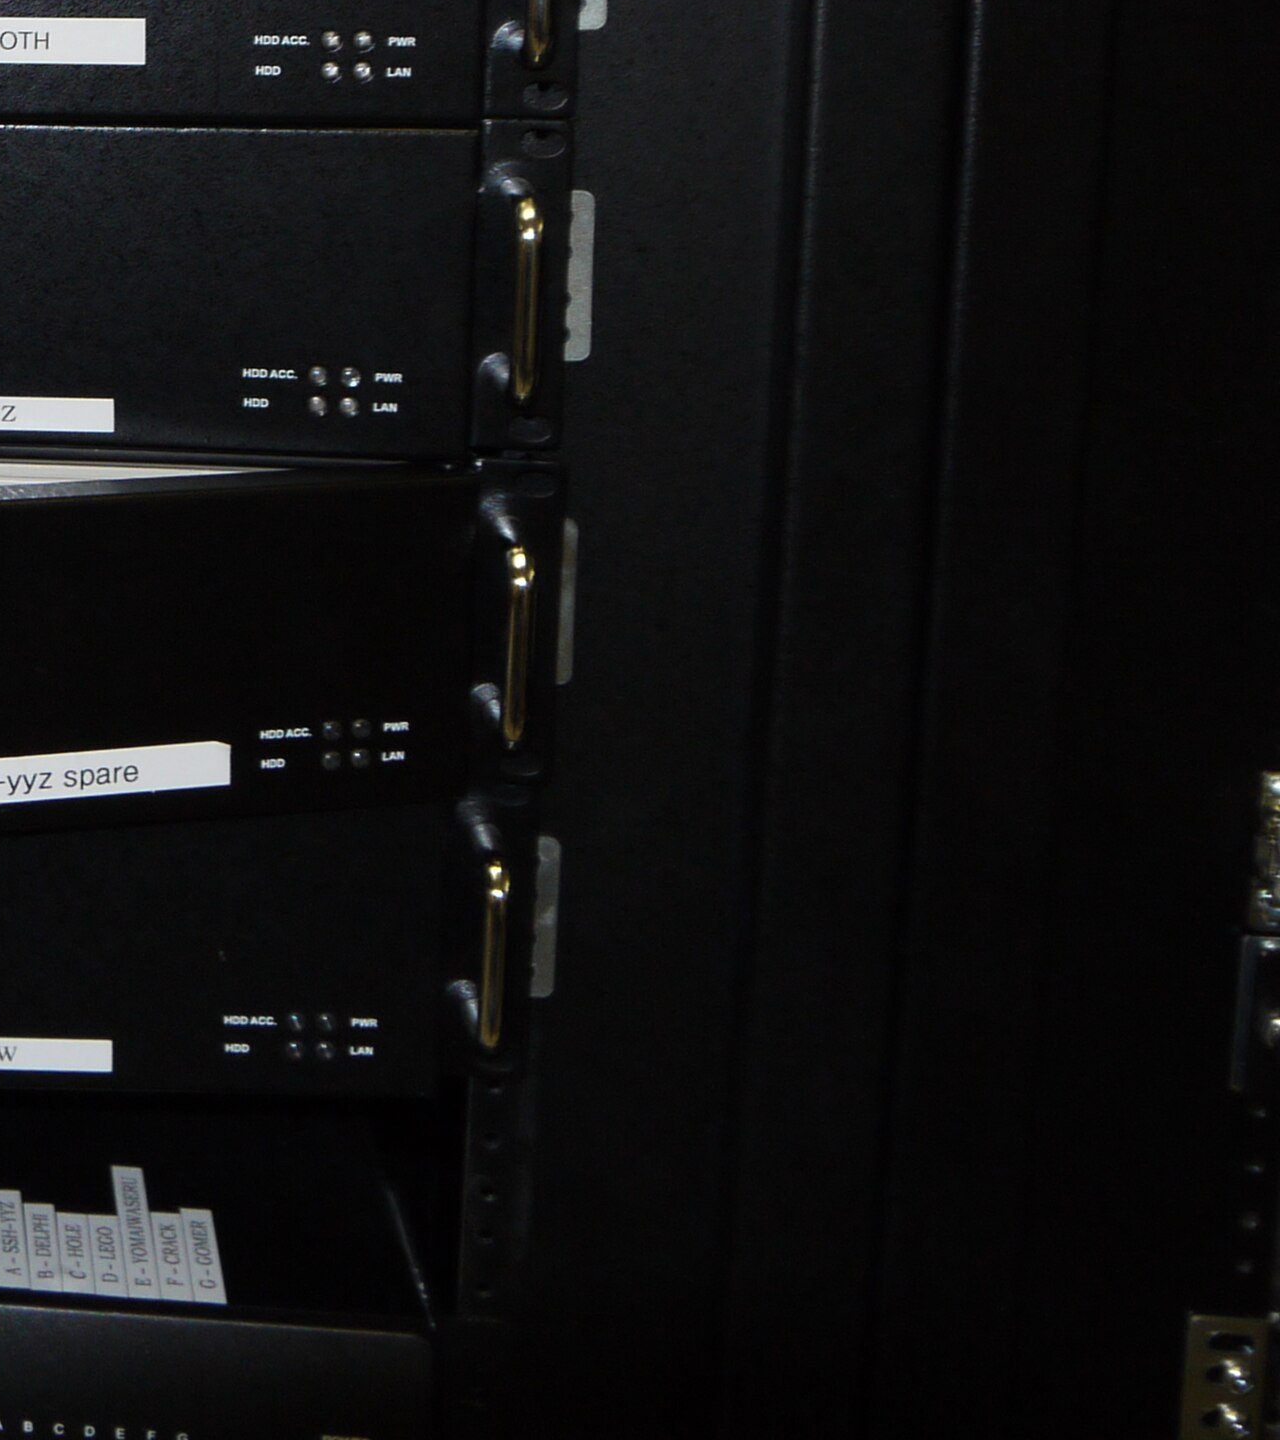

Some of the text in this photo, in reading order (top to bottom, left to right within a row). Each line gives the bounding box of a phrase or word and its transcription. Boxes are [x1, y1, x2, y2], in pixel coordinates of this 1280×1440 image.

[253, 35, 280, 46] HDD
[387, 36, 416, 47] PWR
[255, 65, 282, 76] HDD
[385, 67, 412, 78] LAN
[242, 368, 268, 378] HDD
[374, 372, 403, 383] PWR
[243, 398, 269, 408] HDD
[372, 402, 398, 413] LAN
[383, 721, 410, 732] PWR
[260, 729, 284, 740] HDD
[382, 751, 405, 761] LAN
[260, 759, 286, 769] HDD
[63, 764, 140, 794] spare
[223, 1015, 248, 1025] HDD
[351, 1017, 378, 1027] PWR
[224, 1043, 250, 1053] HDD
[349, 1045, 374, 1056] LAN
[121, 1176, 148, 1264] YOMAIWASERU
[34, 1212, 52, 1258] DELPHI
[65, 1224, 84, 1258] HOLE
[96, 1226, 116, 1260] LEGO
[160, 1223, 181, 1265] CRACK
[193, 1220, 214, 1266] GOMER
[5, 1266, 21, 1276] A
[37, 1270, 54, 1279] B
[69, 1270, 87, 1280] C
[102, 1273, 119, 1283] D
[135, 1278, 152, 1287] E
[167, 1277, 184, 1287] F
[200, 1280, 217, 1289] G
[23, 1421, 34, 1432] B
[53, 1423, 64, 1435] C
[84, 1425, 95, 1437] D
[115, 1427, 125, 1439] E
[147, 1430, 156, 1440] F
